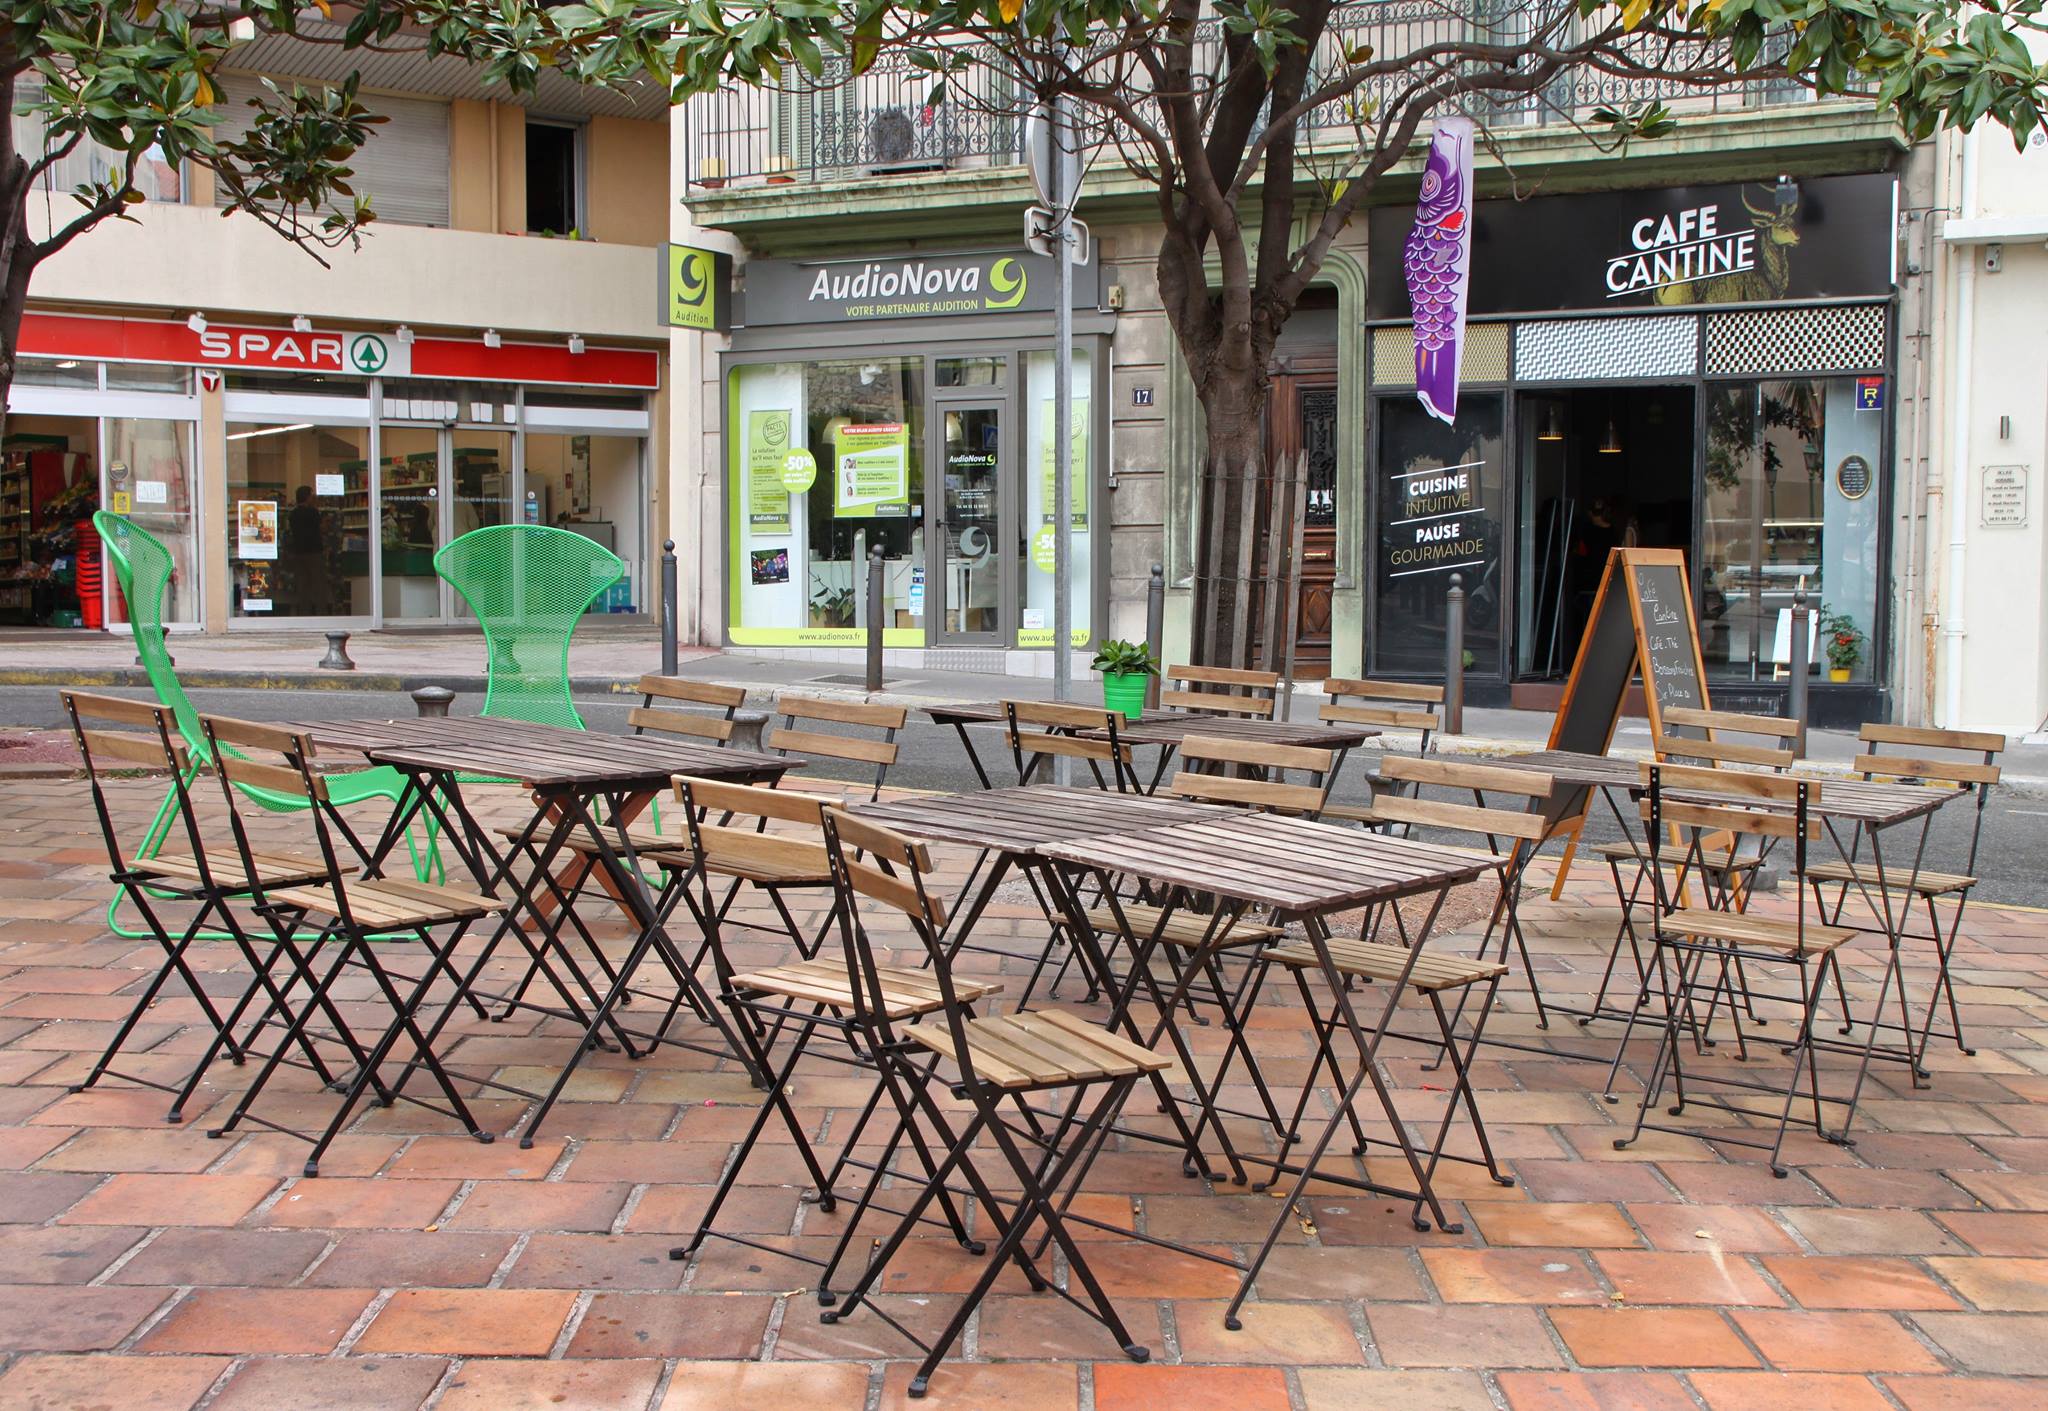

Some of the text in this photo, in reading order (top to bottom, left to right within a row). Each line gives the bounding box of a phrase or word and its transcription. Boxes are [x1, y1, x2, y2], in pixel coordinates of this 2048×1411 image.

[1632, 205, 1718, 251] CAFE
[1606, 235, 1756, 292] CANTINE
[808, 263, 981, 301] AudioNova
[675, 311, 709, 323] Audition
[846, 299, 978, 317] VOTRE PARTENAIRE AUDITION
[200, 332, 341, 365] SPAR
[1136, 390, 1149, 403] 17
[783, 455, 813, 472] -50%
[949, 453, 986, 463] AudioNova
[1409, 474, 1468, 497] CUISINE
[1406, 492, 1471, 518] INTUITIVE
[1416, 523, 1460, 543] PAUSE
[1391, 539, 1484, 565] GOURMANDE
[798, 632, 861, 641] www.audionova.fr
